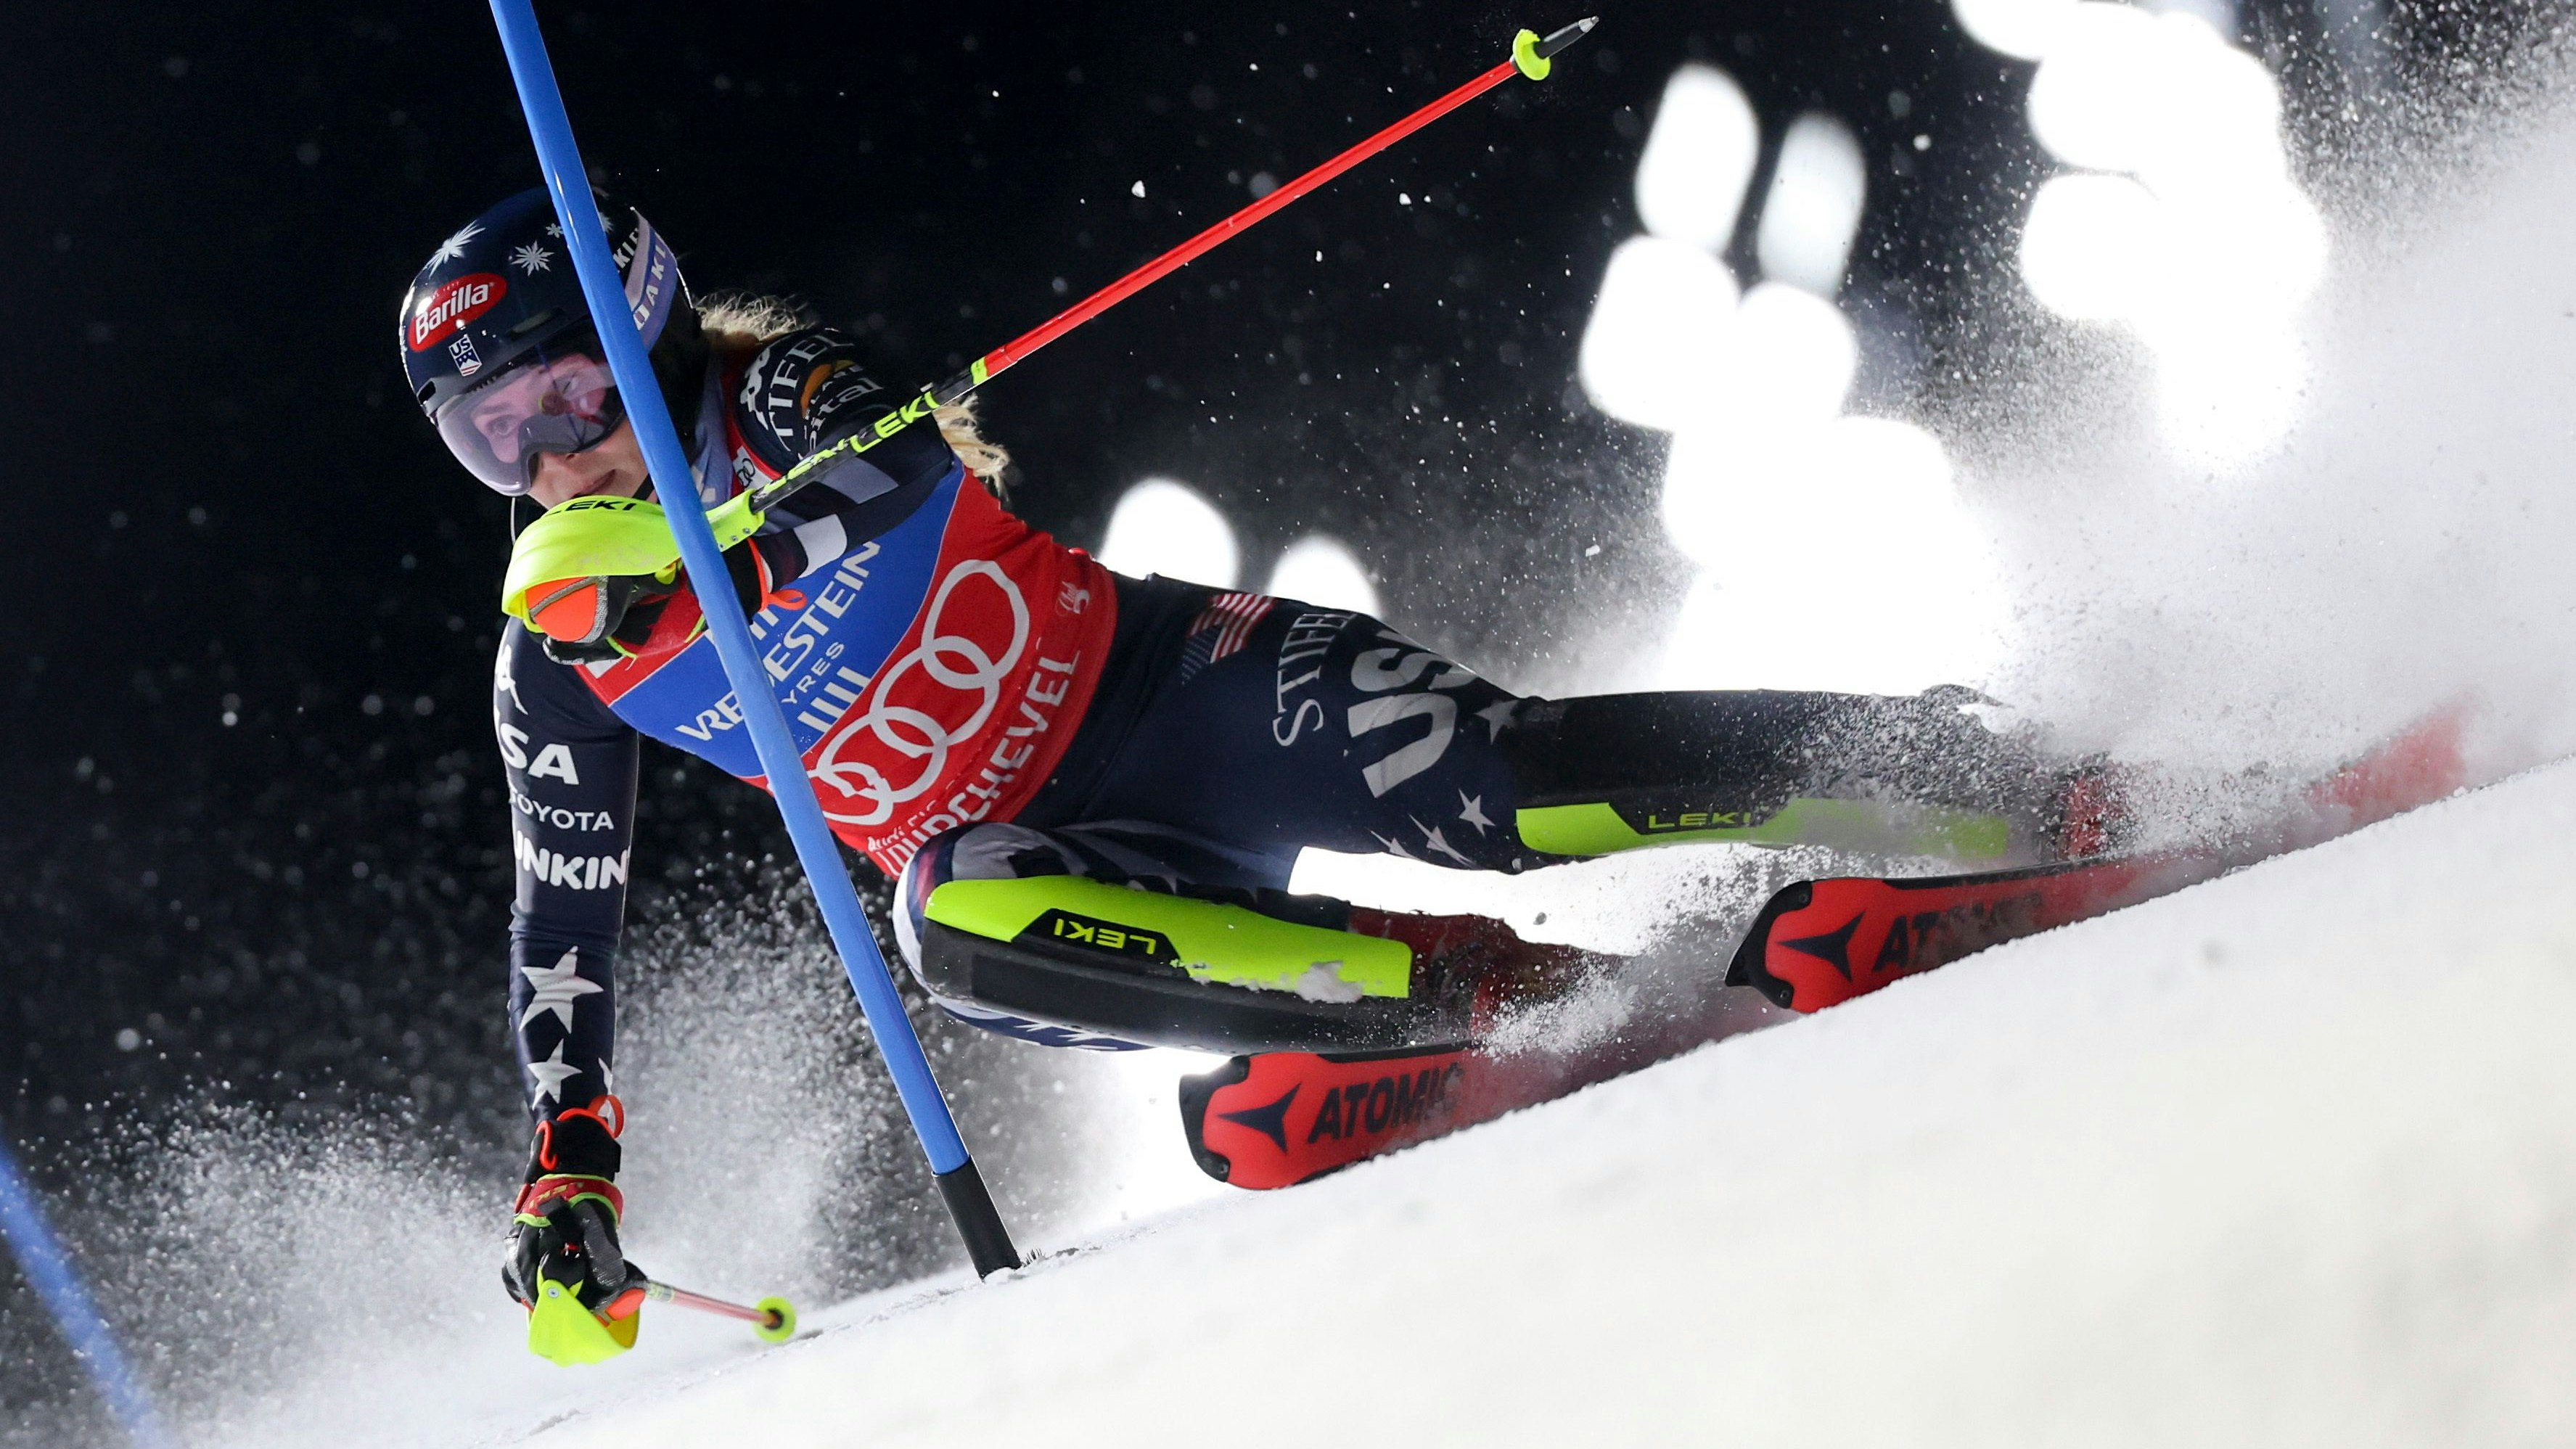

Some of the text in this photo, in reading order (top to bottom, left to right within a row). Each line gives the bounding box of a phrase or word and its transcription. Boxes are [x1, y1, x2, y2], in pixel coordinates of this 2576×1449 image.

[633, 232, 666, 331] OAKL
[415, 283, 489, 345] Barilla
[450, 337, 471, 356] US
[768, 334, 855, 452] TIFEL
[850, 390, 941, 453] LEKI
[674, 541, 881, 742] VREESTEIN
[781, 641, 845, 704] YRES
[499, 722, 580, 785] SA
[1648, 812, 1752, 829] LEKI
[1054, 918, 1157, 955] LEKI
